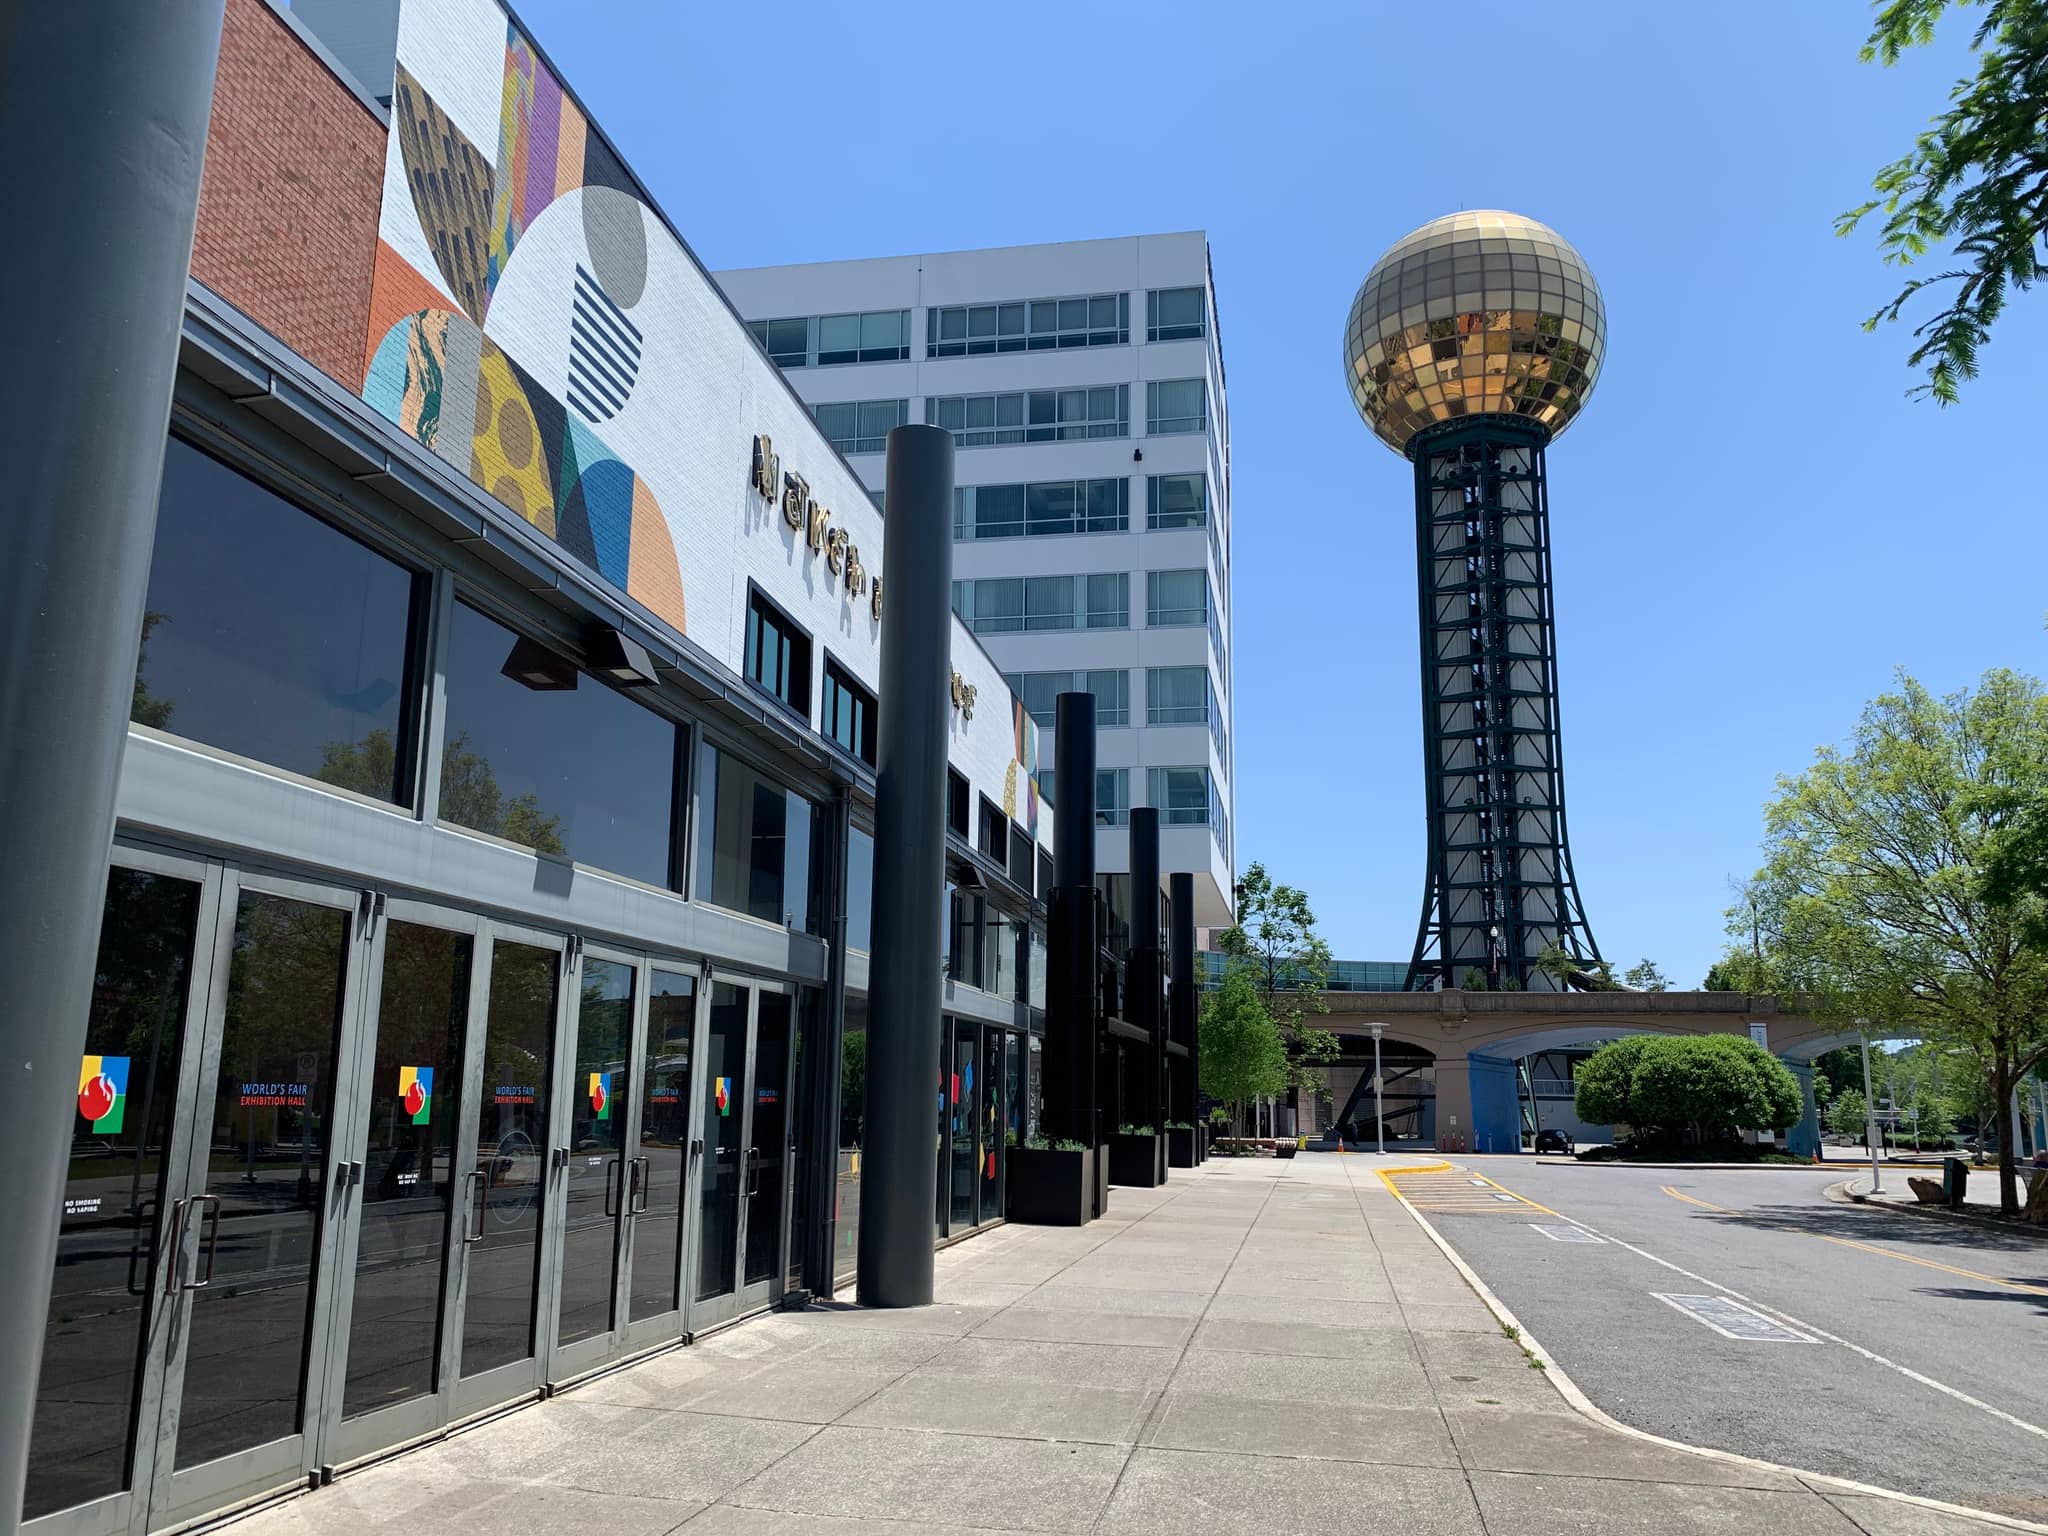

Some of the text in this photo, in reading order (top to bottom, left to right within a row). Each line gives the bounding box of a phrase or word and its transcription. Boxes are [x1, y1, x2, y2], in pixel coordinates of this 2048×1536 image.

[242, 1083, 307, 1095] WORLD'S FAIR
[240, 1096, 306, 1106] EXHIBITION HALL
